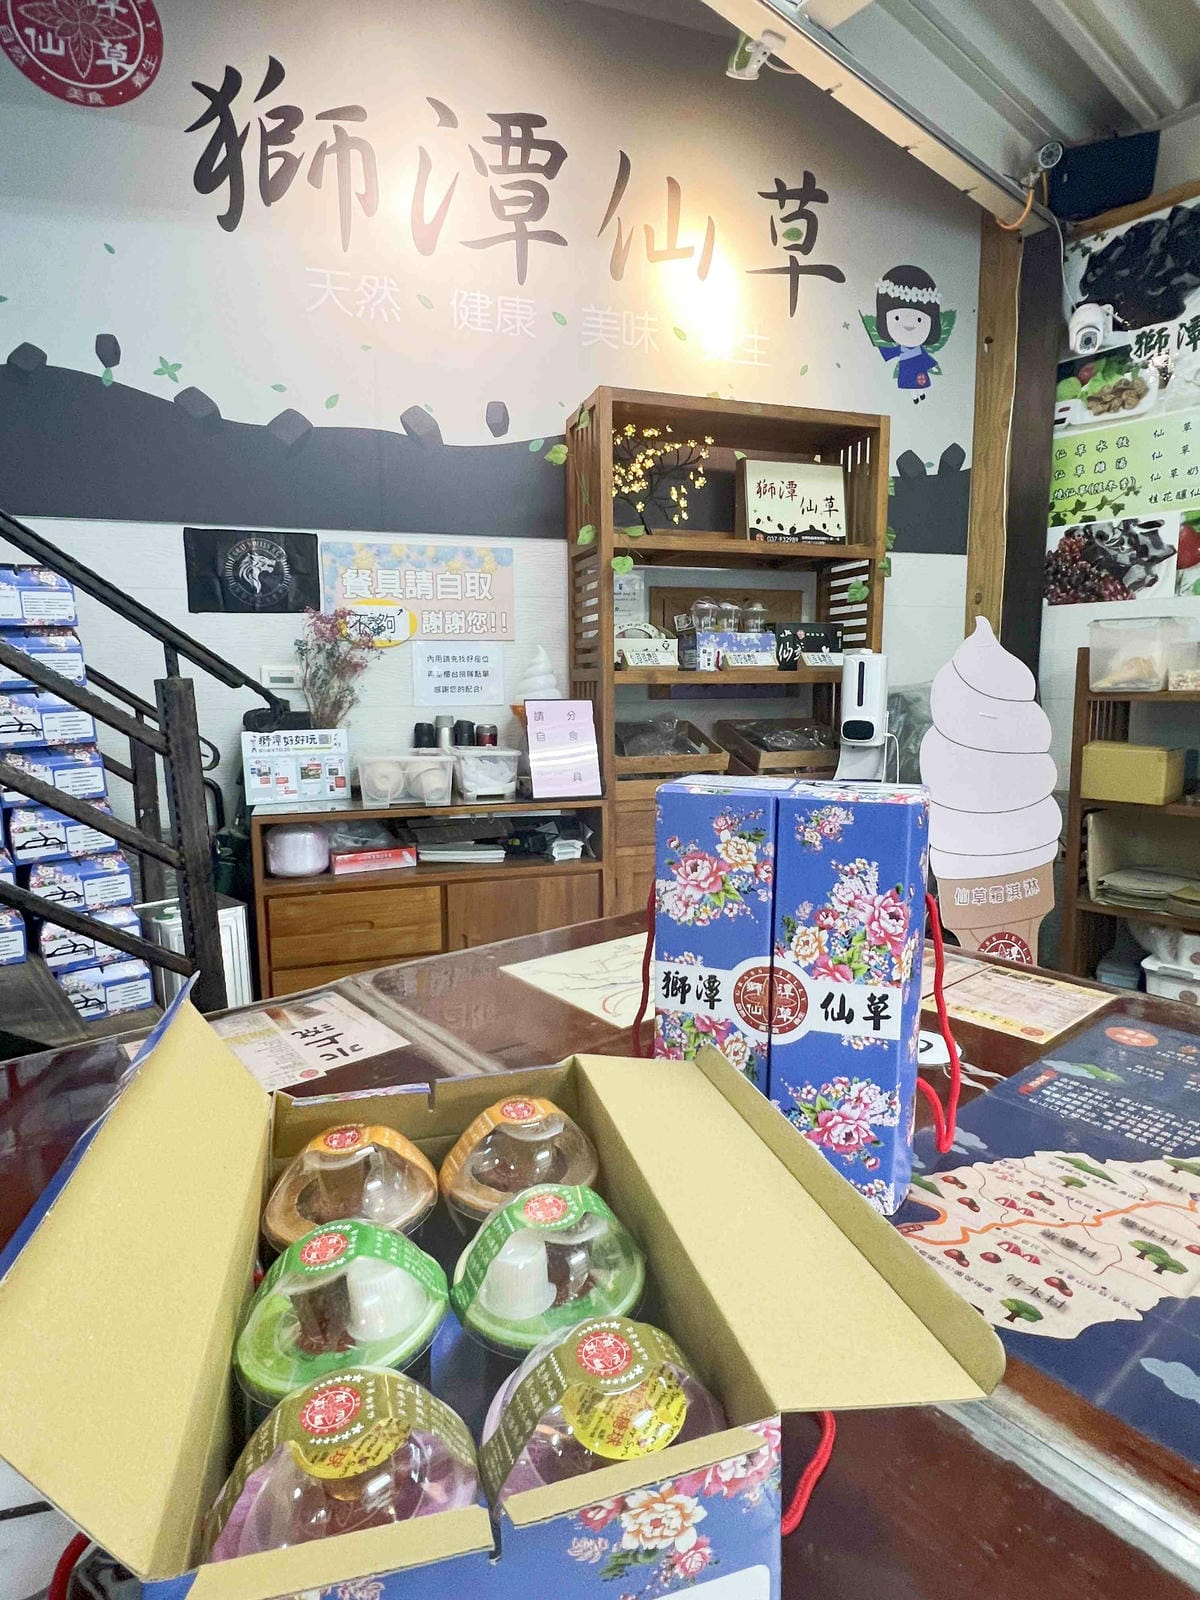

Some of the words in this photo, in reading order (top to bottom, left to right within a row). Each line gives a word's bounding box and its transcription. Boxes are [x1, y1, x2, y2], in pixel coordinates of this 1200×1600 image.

[184, 56, 846, 318] 獅潭仙草
[304, 266, 402, 323] 天然
[449, 287, 537, 339] 健康
[581, 304, 661, 354] 美味
[756, 479, 798, 501] 獅潭
[800, 495, 840, 518] 仙草
[342, 568, 495, 601] 餐具請自取
[421, 610, 508, 636] 謝謝您!!
[954, 877, 1040, 906] 仙草霜淇淋
[661, 971, 722, 1011] 獅潭
[820, 991, 892, 1031] 仙草
